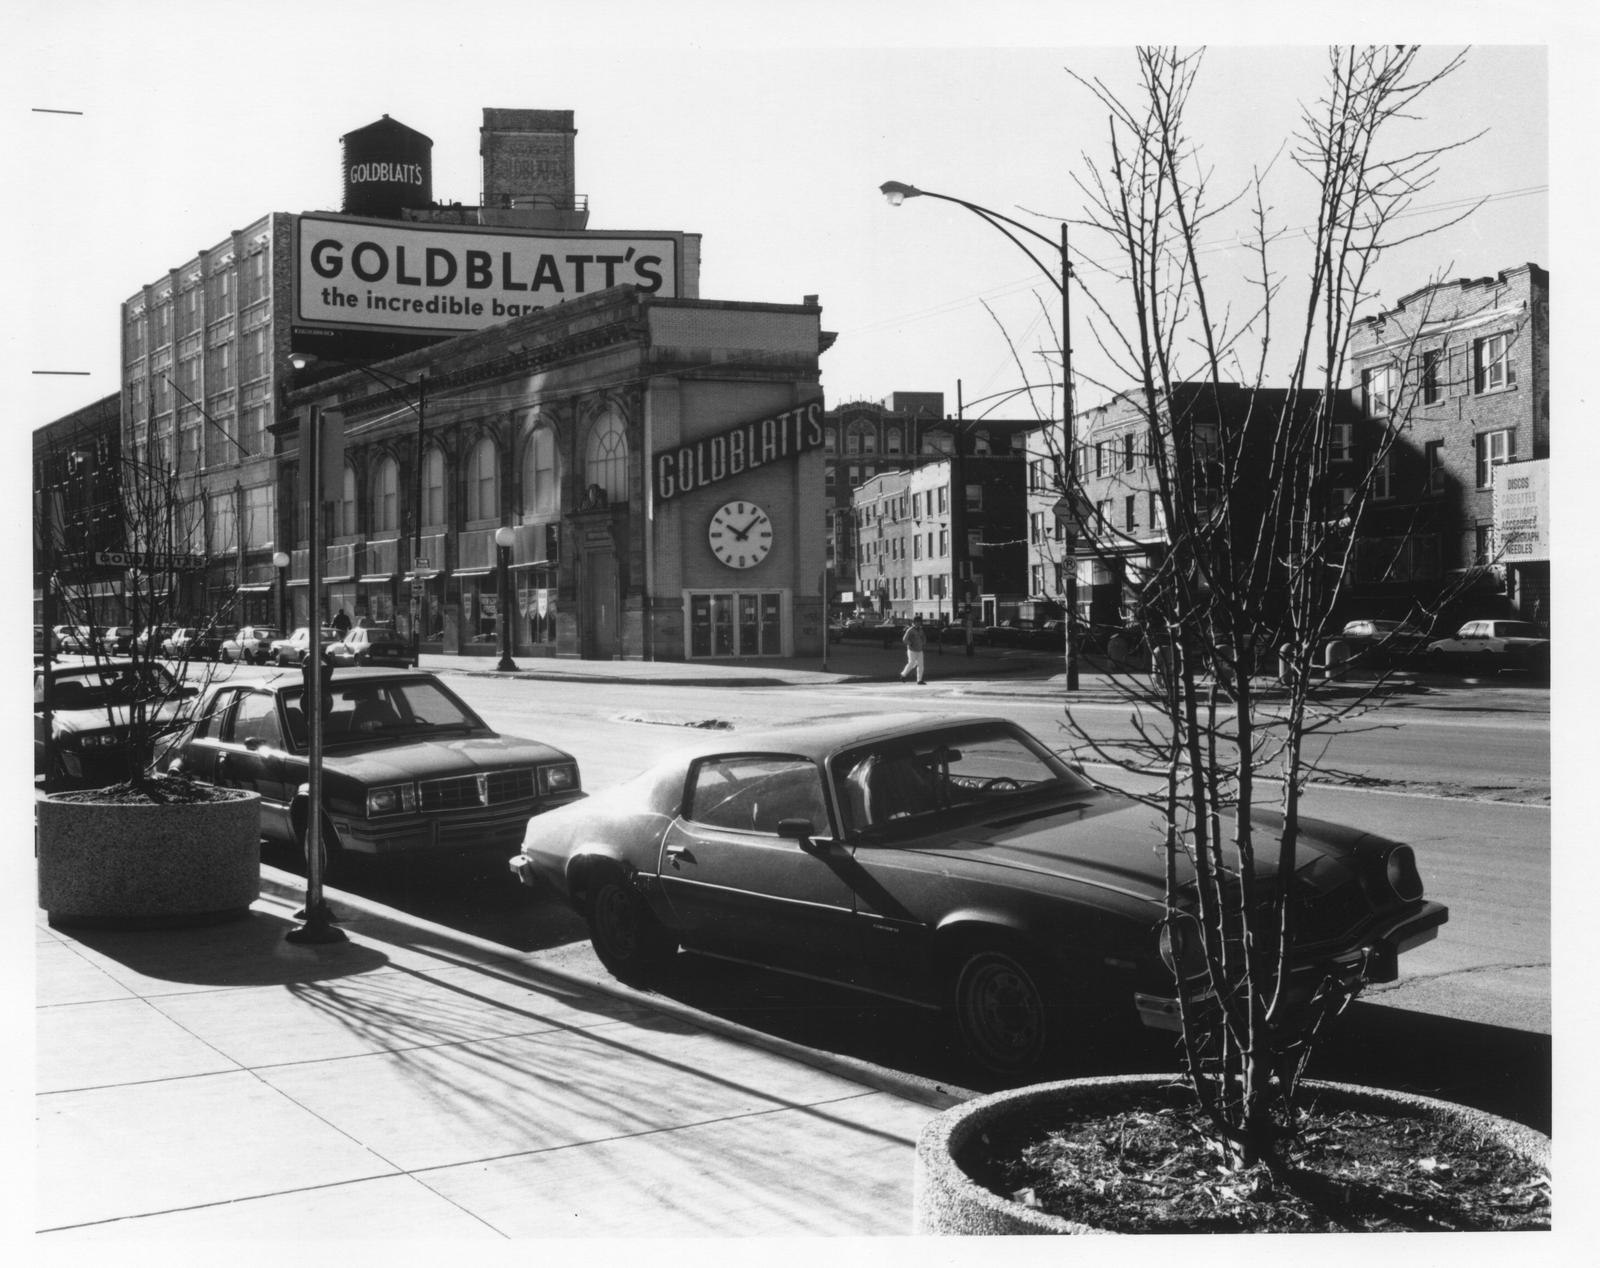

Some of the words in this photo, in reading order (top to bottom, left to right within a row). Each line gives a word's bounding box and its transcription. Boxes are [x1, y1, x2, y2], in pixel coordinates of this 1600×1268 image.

[350, 162, 423, 186] GOLDBLATT'S
[310, 238, 663, 294] GOLDBLATT'S
[321, 287, 359, 308] the
[366, 290, 484, 316] incredible
[1506, 543, 1533, 555] NEEDLES
